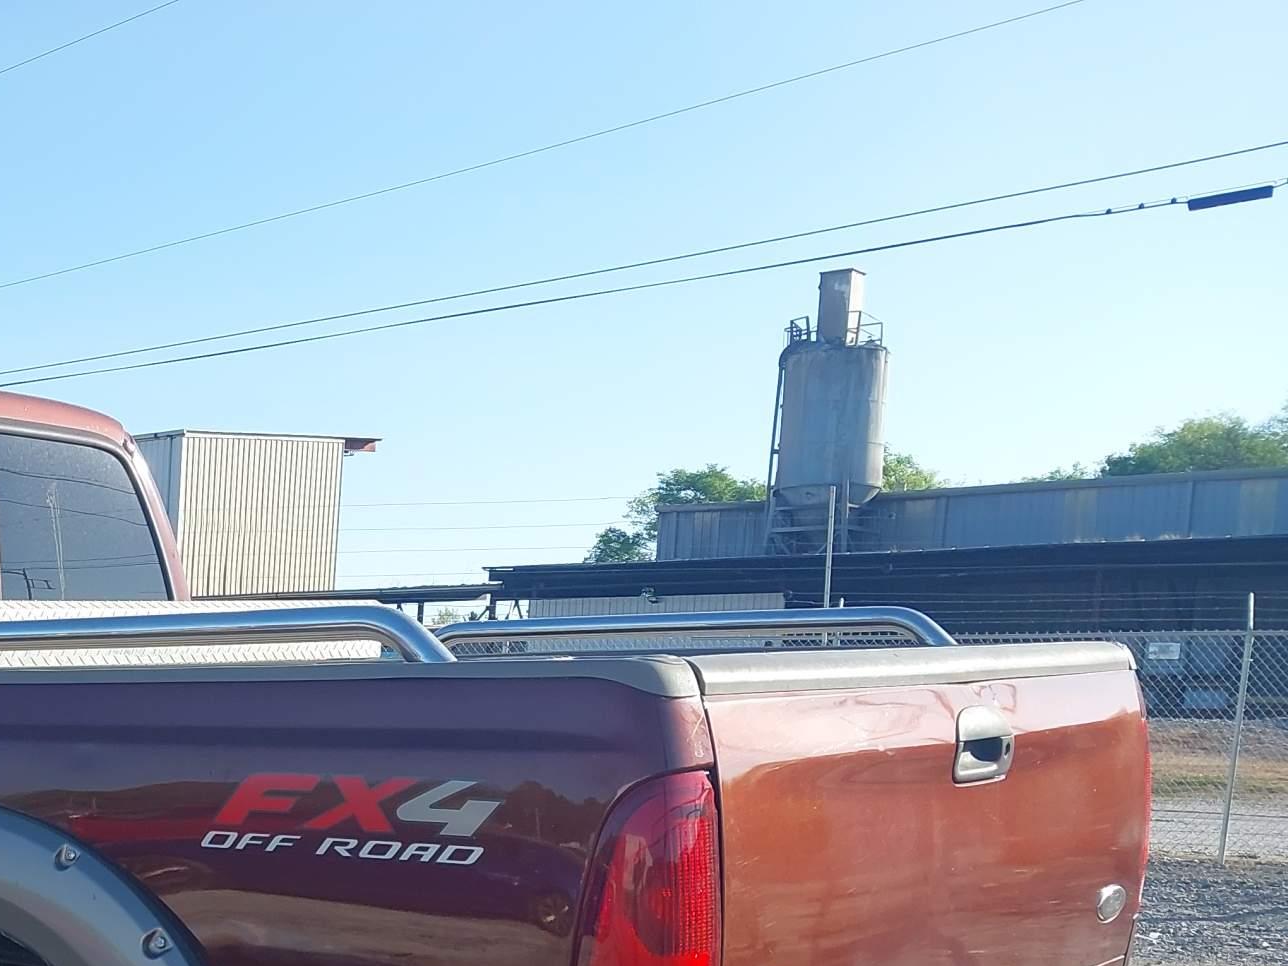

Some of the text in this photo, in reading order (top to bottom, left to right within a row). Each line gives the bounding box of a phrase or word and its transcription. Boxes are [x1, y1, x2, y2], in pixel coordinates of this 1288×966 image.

[214, 771, 503, 837] FX4
[200, 830, 485, 865] OFF ROAD
